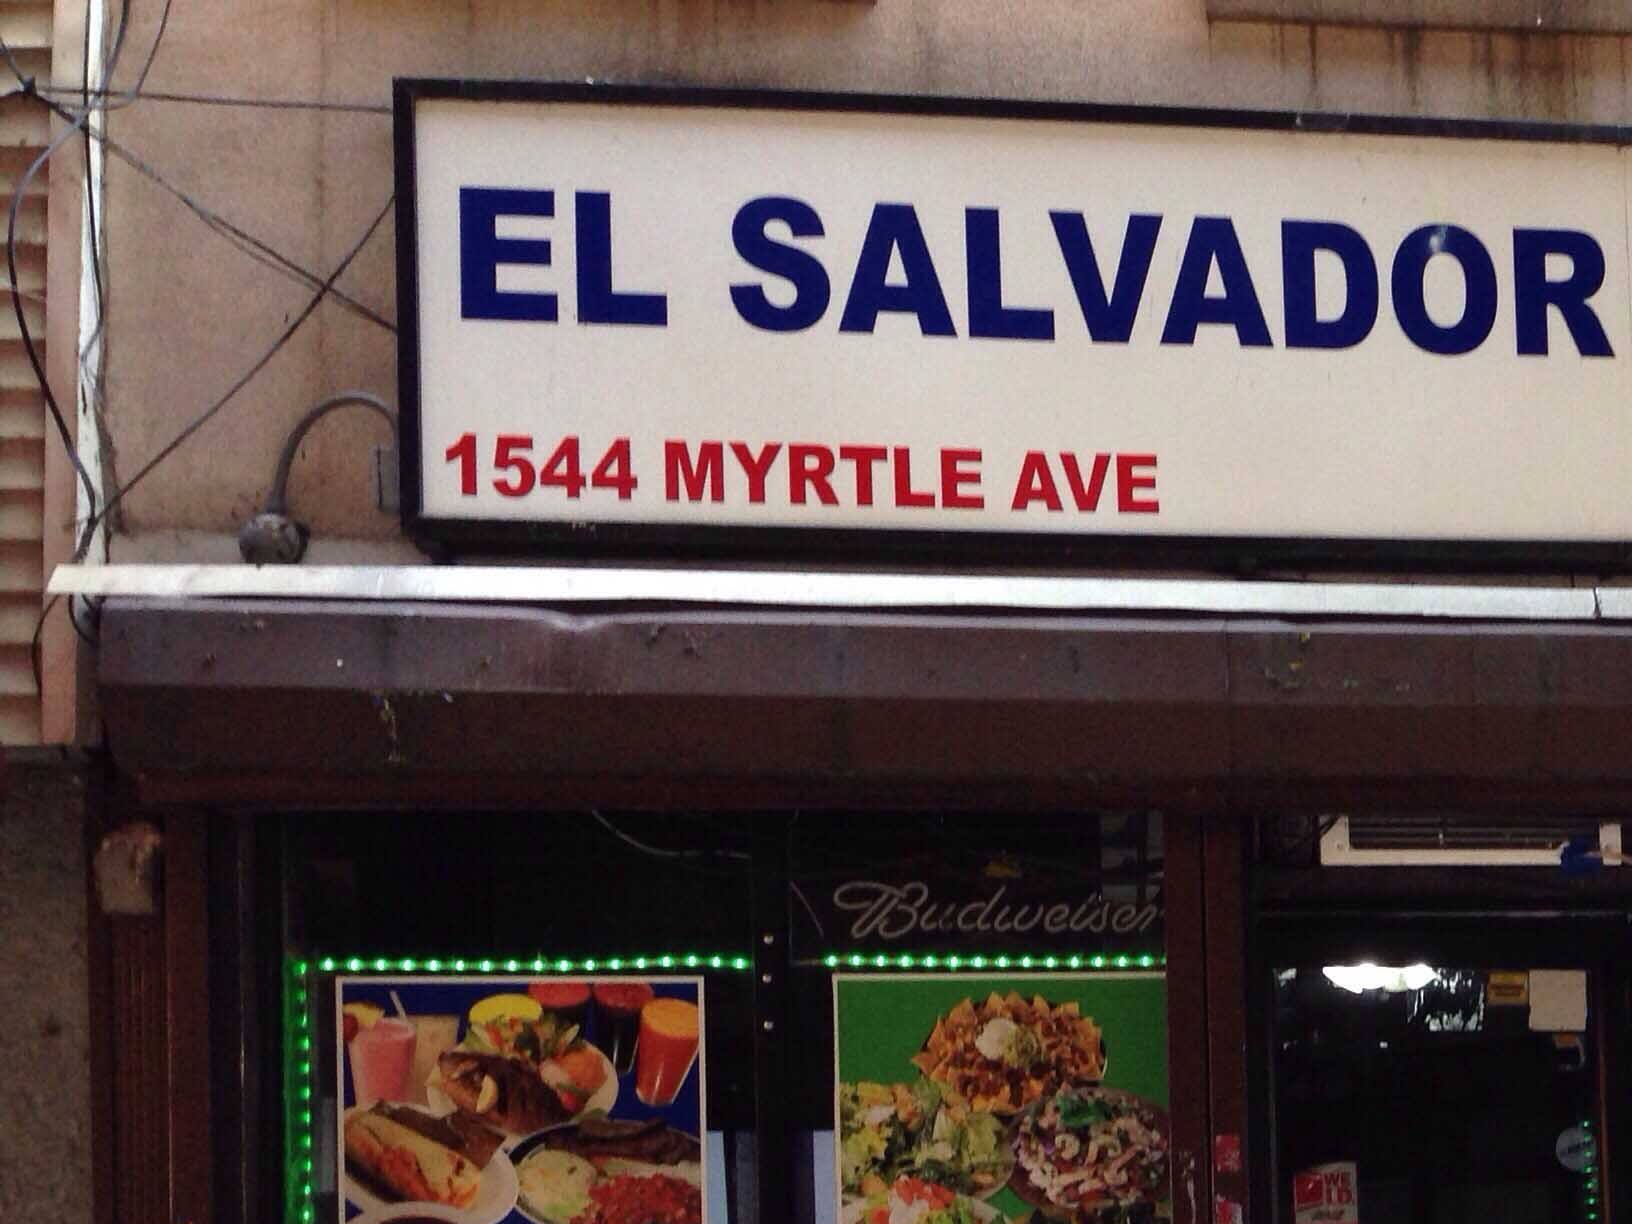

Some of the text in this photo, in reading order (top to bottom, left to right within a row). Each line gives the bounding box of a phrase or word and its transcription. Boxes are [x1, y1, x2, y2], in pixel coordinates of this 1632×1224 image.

[459, 186, 668, 326] EL
[729, 196, 1615, 358] SALVADOR
[445, 433, 1160, 514] 1544 MYRTLE AVE
[833, 880, 1165, 940] Budweiser
